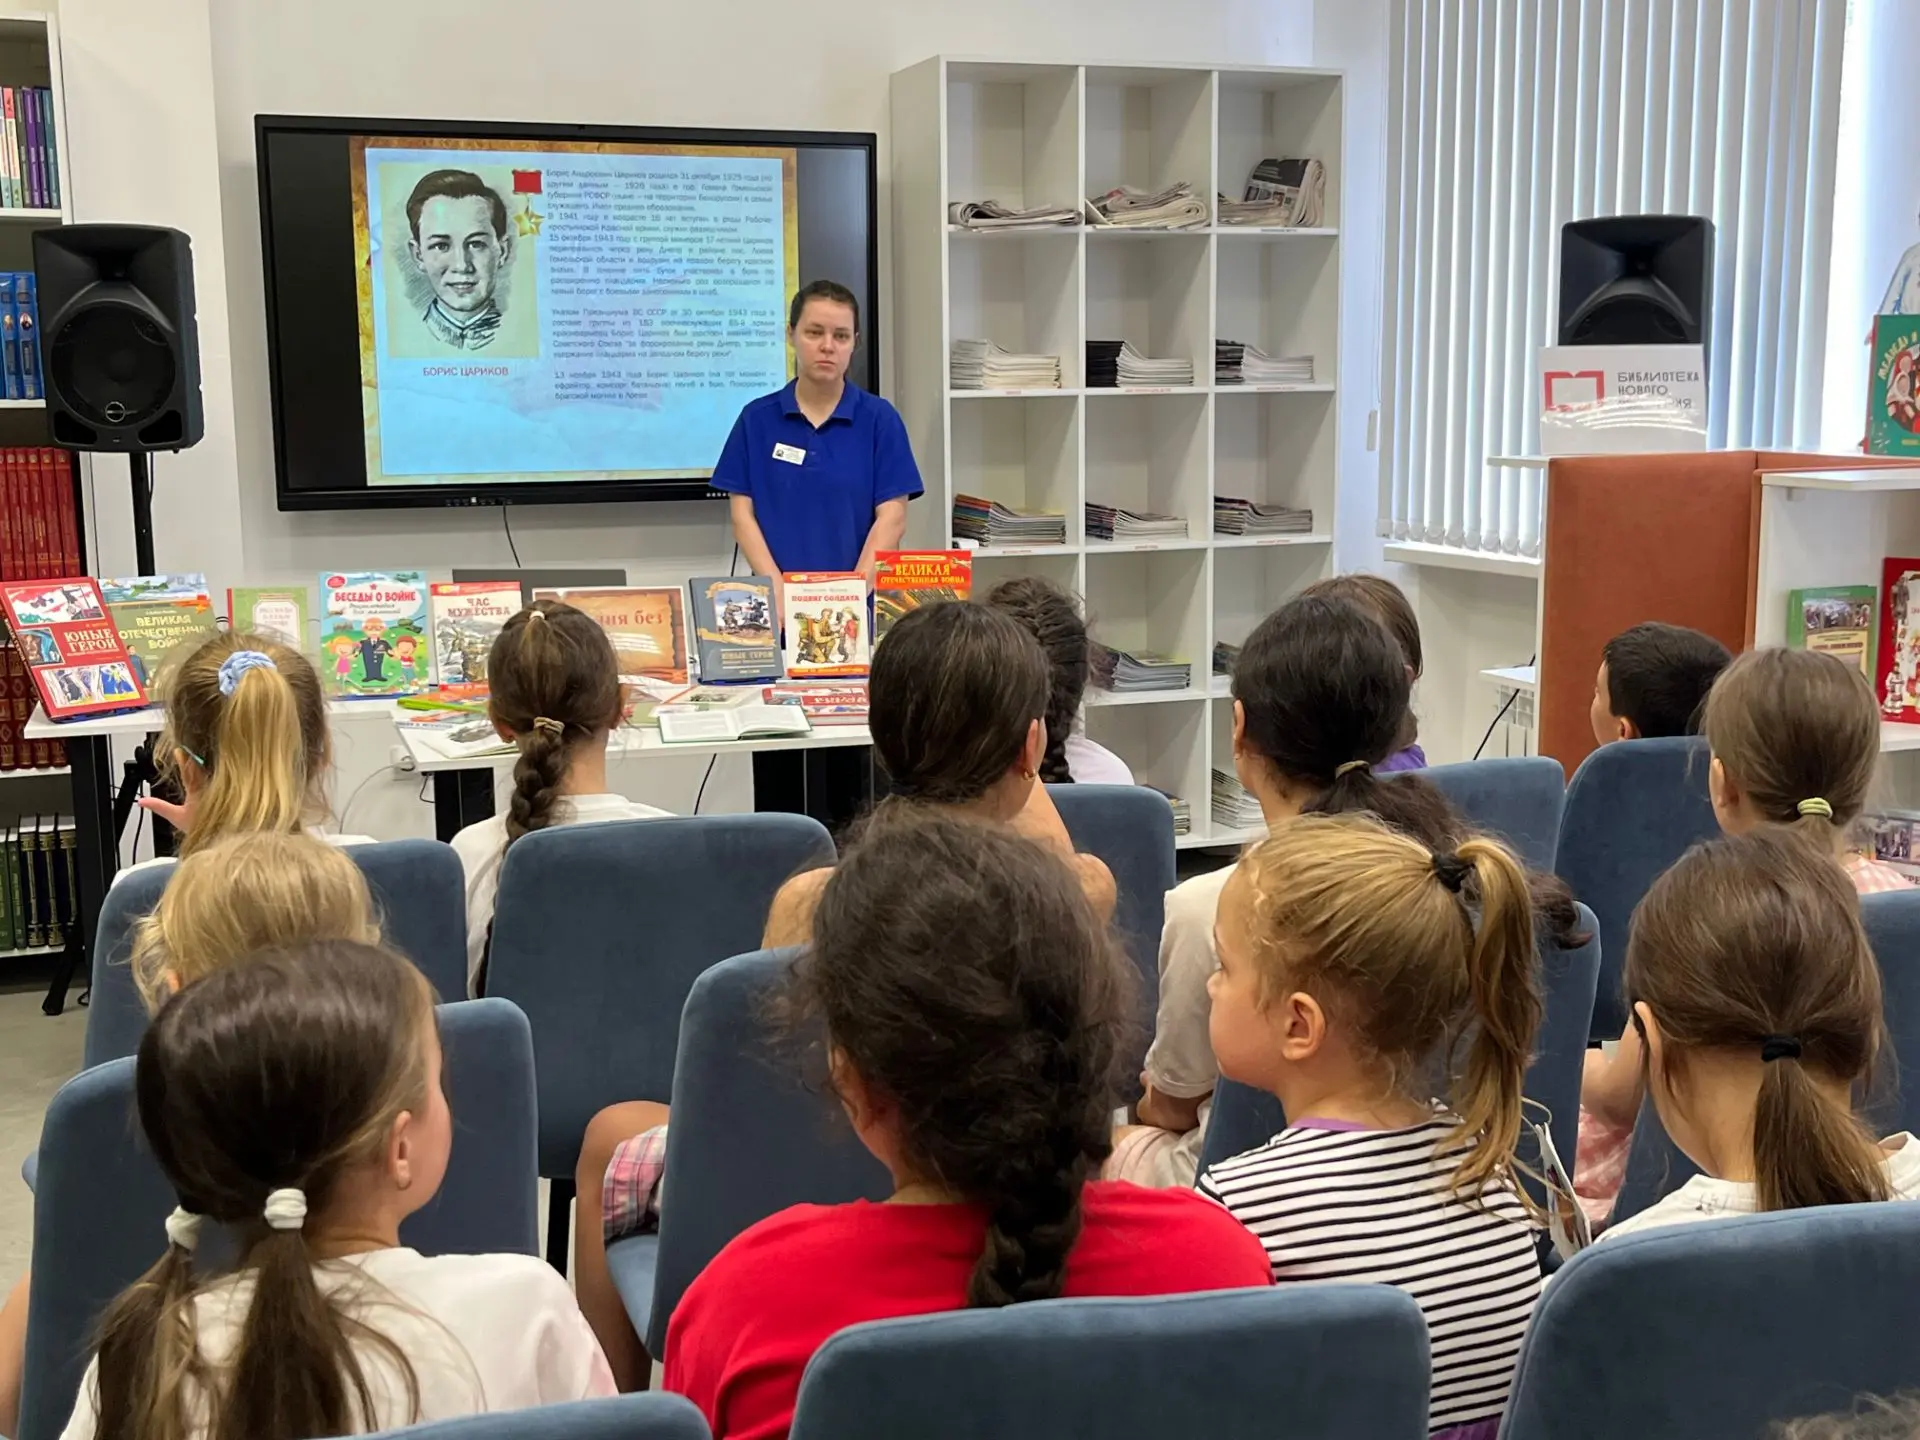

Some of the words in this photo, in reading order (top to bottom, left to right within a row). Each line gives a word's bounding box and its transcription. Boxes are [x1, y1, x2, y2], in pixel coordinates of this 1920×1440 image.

[423, 367, 457, 376] БОРИС
[460, 367, 508, 377] ЦАРИКОВ
[1617, 371, 1699, 382] БИБЛИОТЕКА
[1618, 384, 1668, 395] НОВОГО
[895, 563, 950, 576] ВЕЛИКАЯ
[880, 576, 939, 584] ОТЕЧЕСТВЕННАЯ
[335, 592, 372, 602] БЕСЕДЫ
[375, 592, 382, 601] О
[385, 590, 416, 601] ВОЙНЕ
[467, 598, 490, 607] ЧАС
[448, 607, 510, 617] МУЖЕСТВА
[136, 615, 192, 627] ВЕЛИКАЯ
[64, 629, 114, 643] ЮНЫЕ
[68, 640, 118, 653] ГЕРОИ
